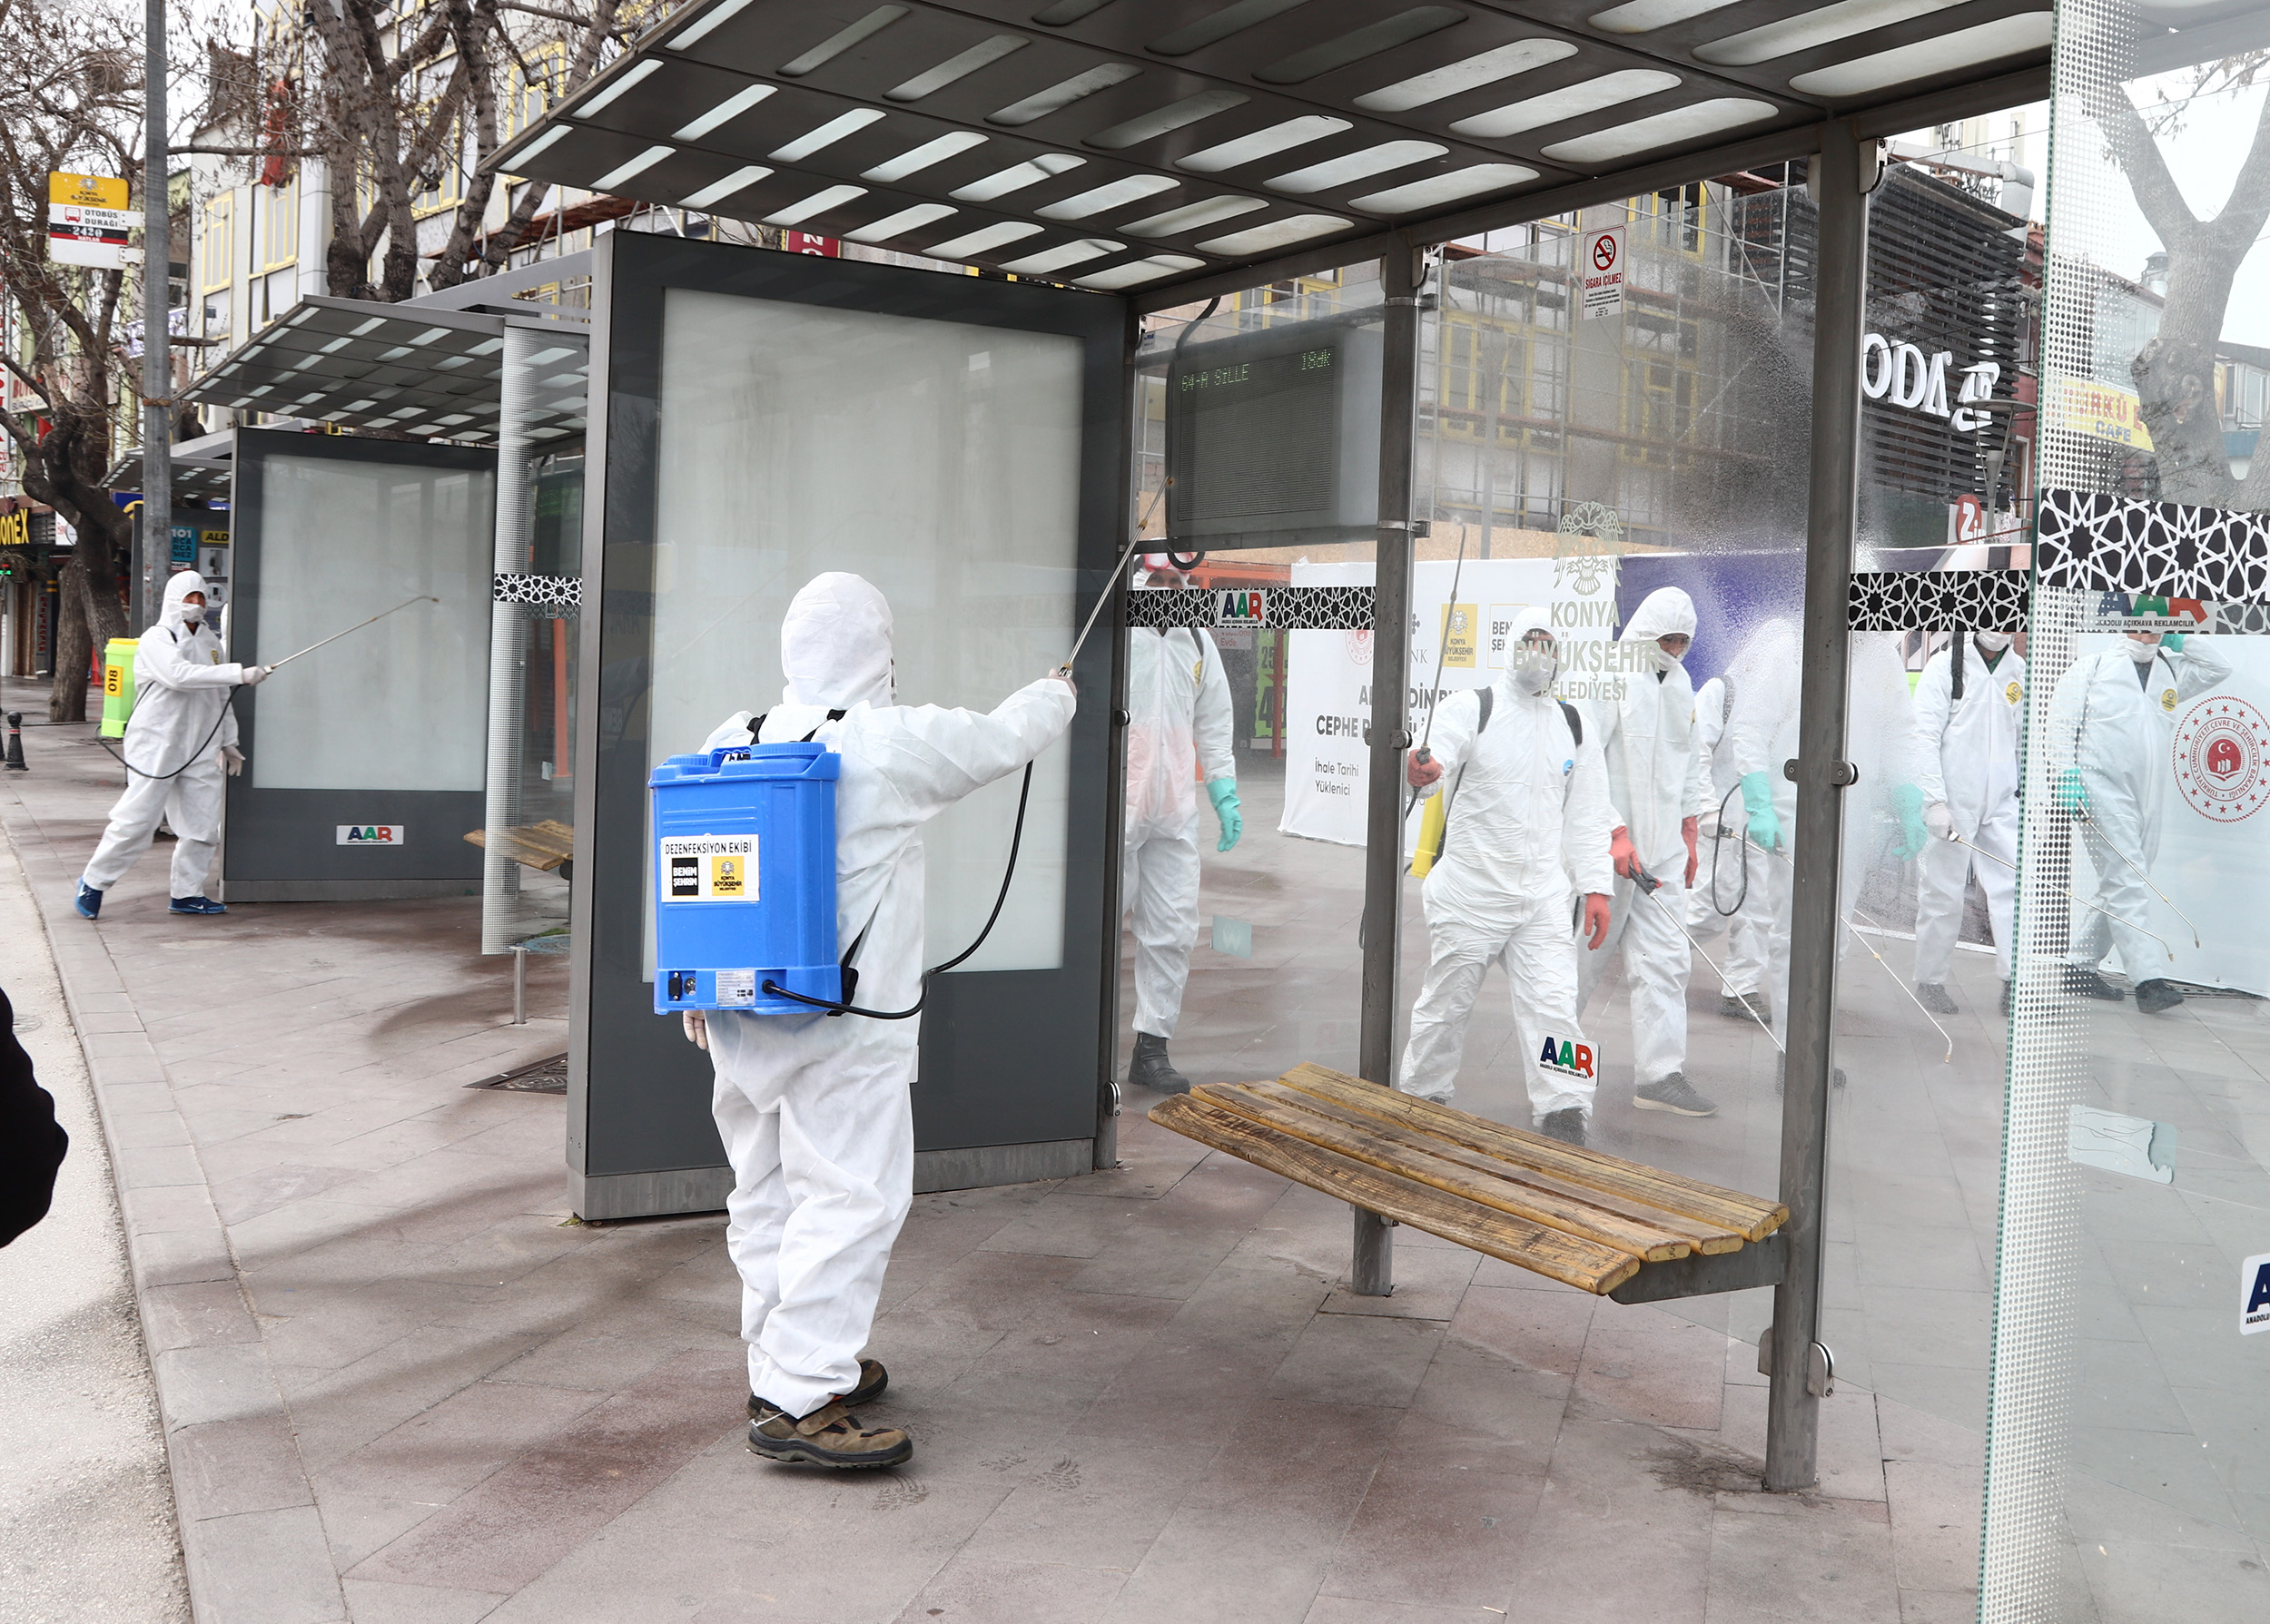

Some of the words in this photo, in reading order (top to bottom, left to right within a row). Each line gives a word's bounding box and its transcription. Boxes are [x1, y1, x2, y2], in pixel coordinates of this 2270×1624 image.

[84, 210, 118, 218] OTOBÜS
[84, 218, 118, 227] DURAĞI
[1585, 275, 1602, 290] SİGARA
[1603, 271, 1622, 289] İÇİLMEZ
[1182, 372, 1208, 391] 64-A
[2096, 420, 2132, 443] CAFE
[1222, 593, 1263, 622] AAR
[1550, 601, 1621, 627] KONYA
[2123, 620, 2152, 628] AÇIKHAVA
[1514, 632, 1662, 681] BÜYÜKŞEHİR
[108, 670, 118, 692] 018
[1541, 677, 1626, 701] BELEDİYESİ
[1316, 714, 1358, 737] CEPHE
[2210, 719, 2231, 730] ÇEVRE
[2232, 722, 2241, 731] VE
[2191, 725, 2211, 773] CUMHURİYETİ
[2240, 728, 2259, 767] ŞEHİRCİLİK
[1315, 756, 1335, 774] İhale
[1337, 762, 1359, 777] Tarihi
[1315, 779, 1351, 796] Yüklenici
[2196, 774, 2218, 798] TÜRKİYE
[347, 827, 393, 842] AAR
[665, 841, 727, 855] DEZENFEKSİYON
[729, 839, 752, 853] EKİBİ
[673, 866, 697, 877] BENİM
[673, 877, 697, 888] ŞEHRİM
[1540, 1036, 1594, 1078] AAR
